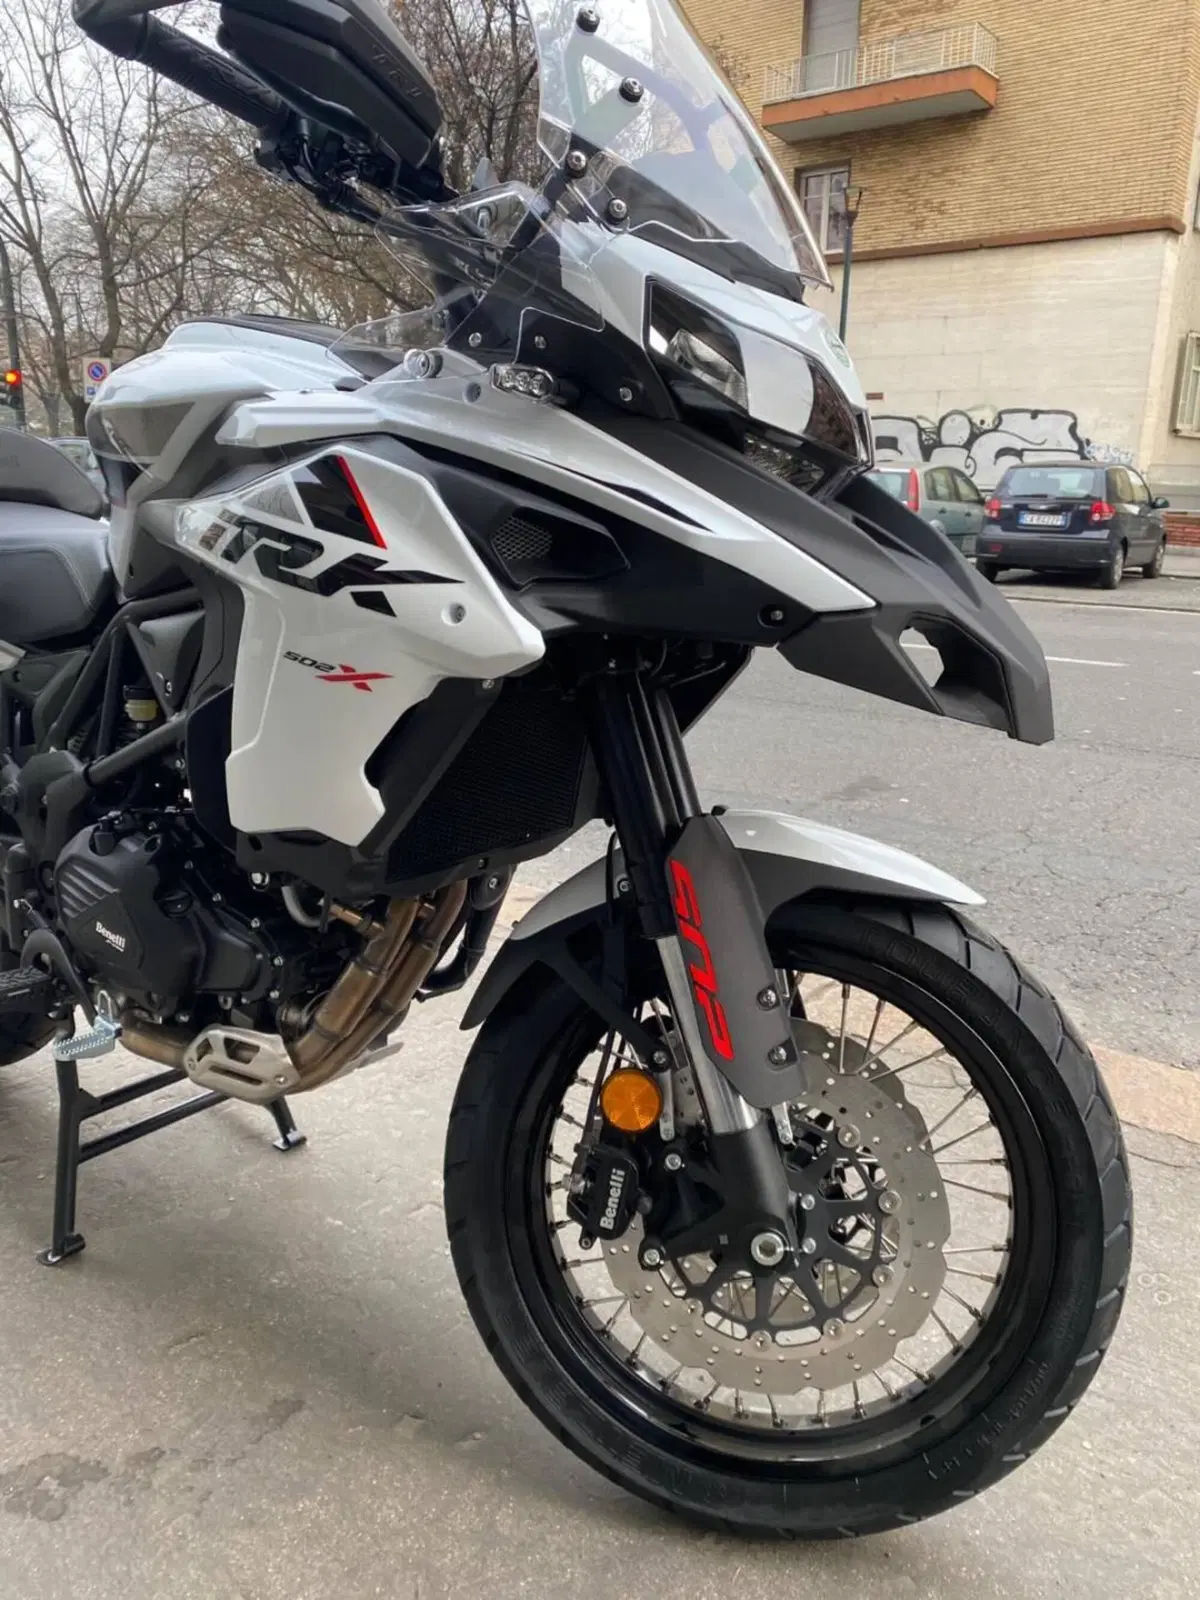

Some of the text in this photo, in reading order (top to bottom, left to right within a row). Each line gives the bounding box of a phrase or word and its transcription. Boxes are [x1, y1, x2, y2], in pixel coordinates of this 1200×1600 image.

[198, 507, 466, 618] TRK
[95, 921, 126, 948] Benelli
[599, 1168, 625, 1230] Benelli
